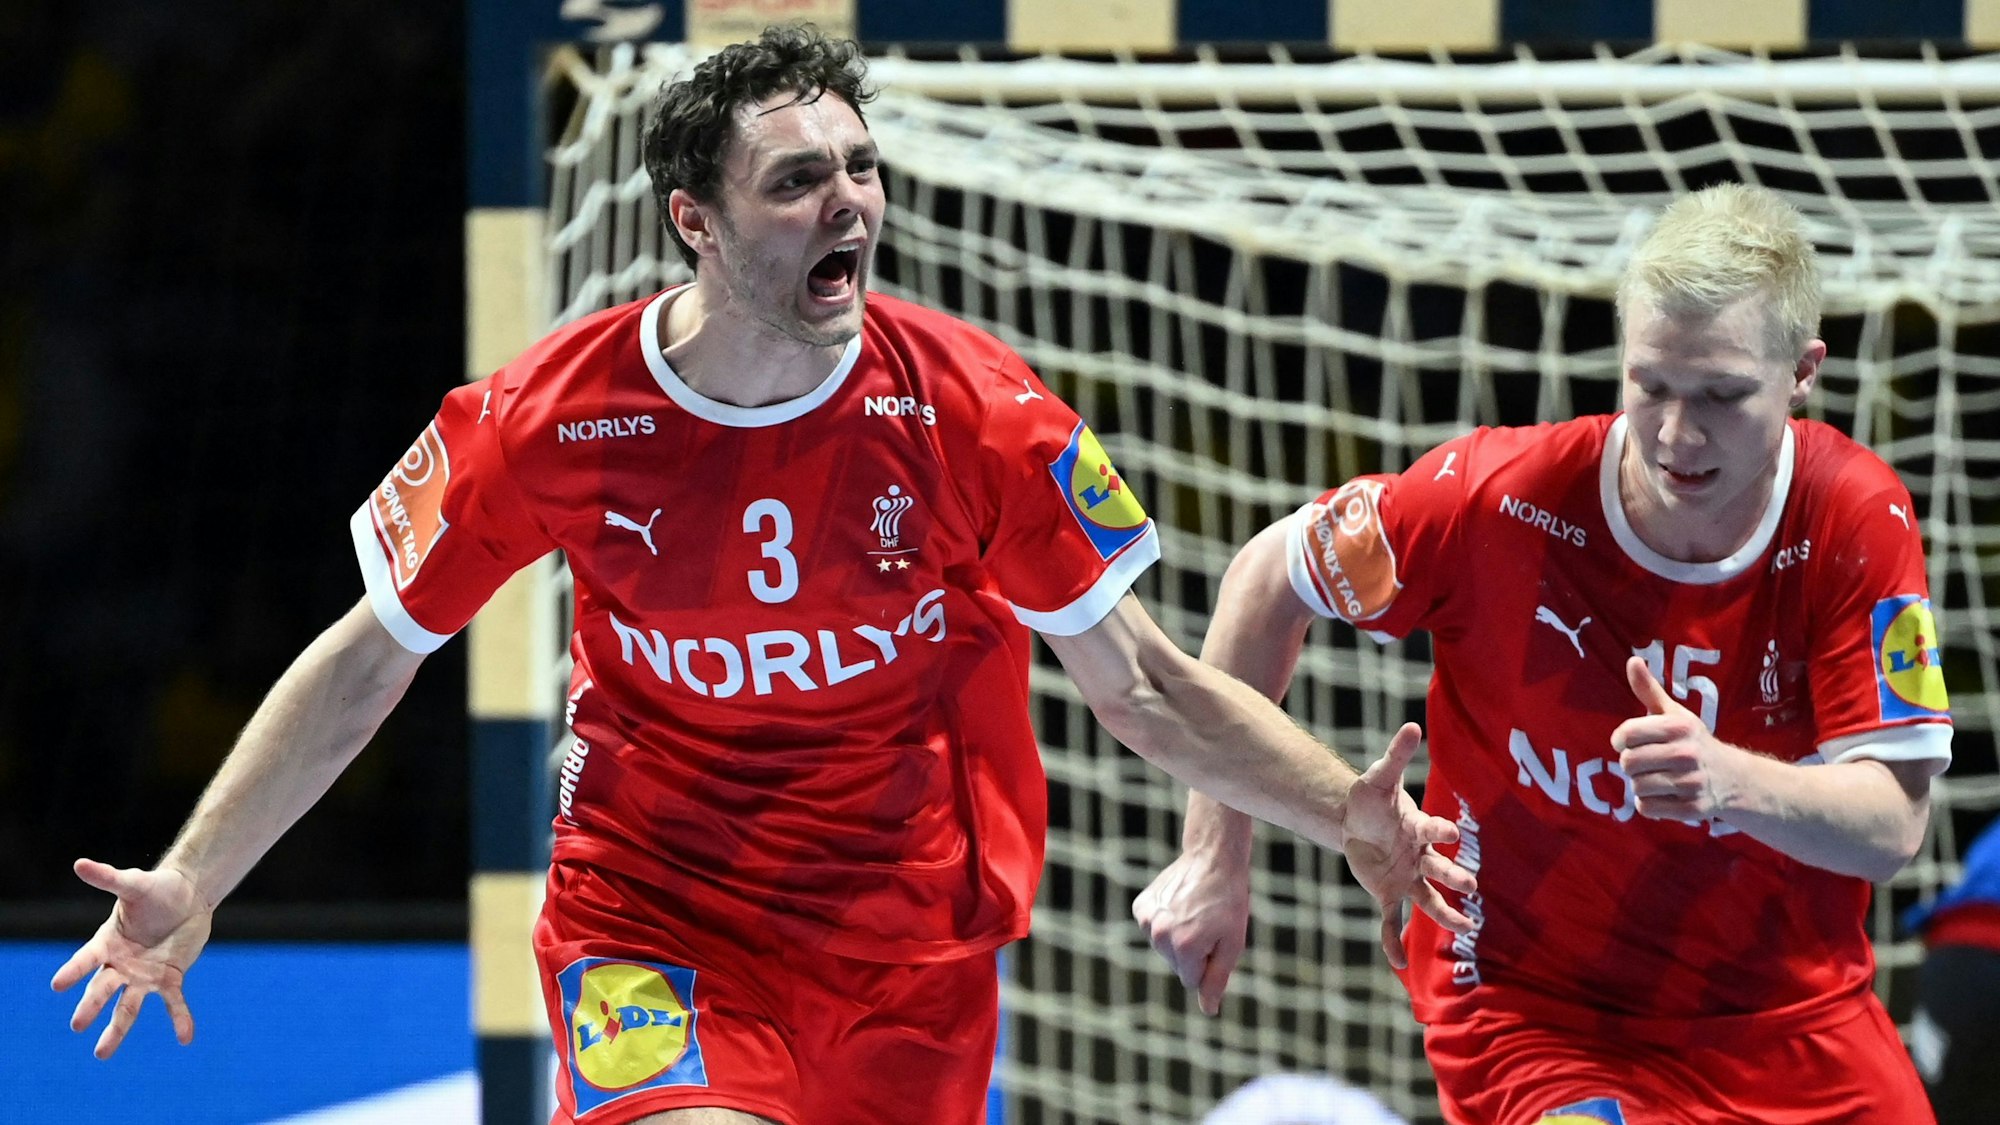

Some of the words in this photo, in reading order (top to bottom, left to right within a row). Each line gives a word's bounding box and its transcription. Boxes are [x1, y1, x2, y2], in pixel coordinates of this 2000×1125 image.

[558, 415, 656, 443] NORLYS
[864, 396, 937, 426] NORS
[1499, 494, 1587, 548] NORLYS
[402, 529, 419, 570] TAG
[742, 498, 799, 604] 3
[880, 536, 899, 548] DHF
[1336, 577, 1362, 617] TAG
[609, 589, 947, 698] NORLYS
